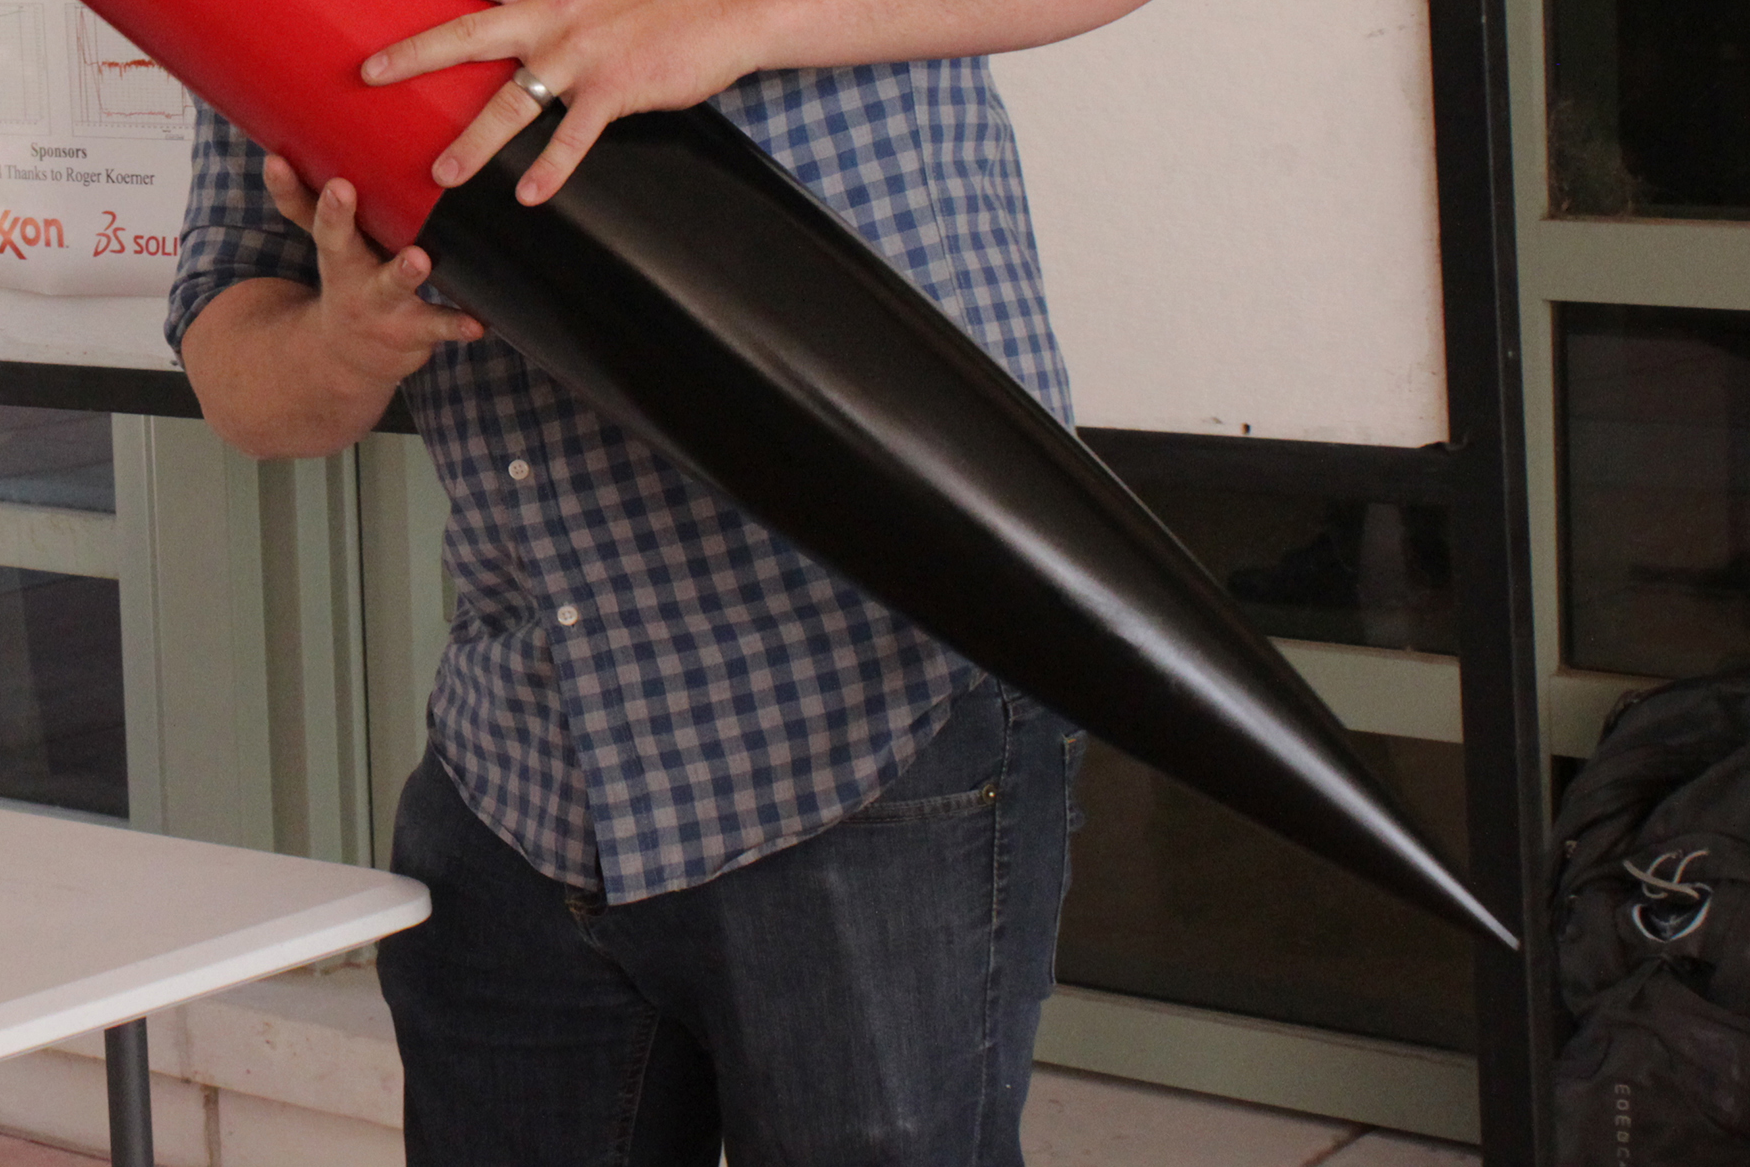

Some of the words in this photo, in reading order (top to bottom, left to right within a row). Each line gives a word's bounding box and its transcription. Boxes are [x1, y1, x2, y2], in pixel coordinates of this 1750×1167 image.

[30, 142, 88, 161] Sponsors
[6, 165, 47, 181] Thanks
[50, 168, 62, 182] to
[66, 167, 102, 188] Roger
